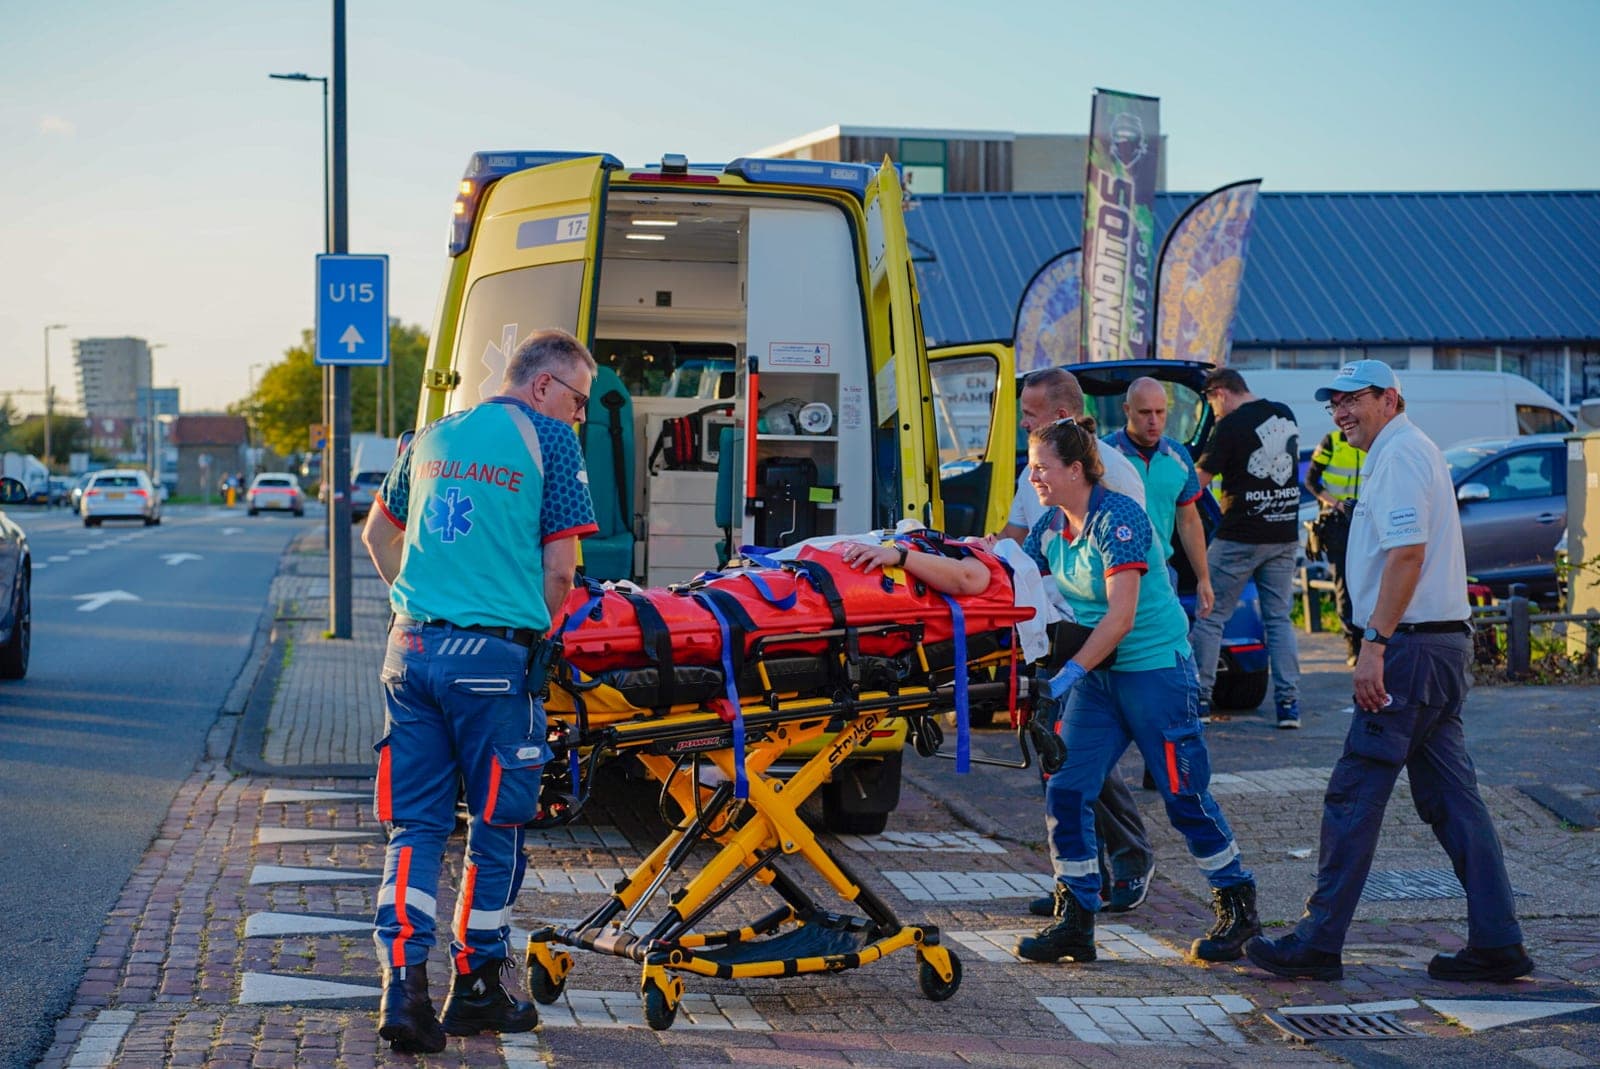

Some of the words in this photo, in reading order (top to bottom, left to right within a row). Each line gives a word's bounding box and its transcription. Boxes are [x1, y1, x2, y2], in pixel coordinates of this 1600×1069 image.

[1094, 172, 1134, 362] BANDITOS
[1129, 220, 1150, 345] ENERGY
[329, 283, 375, 302] U15
[415, 460, 525, 493] MBULANCE
[1246, 490, 1274, 501] ROLL
